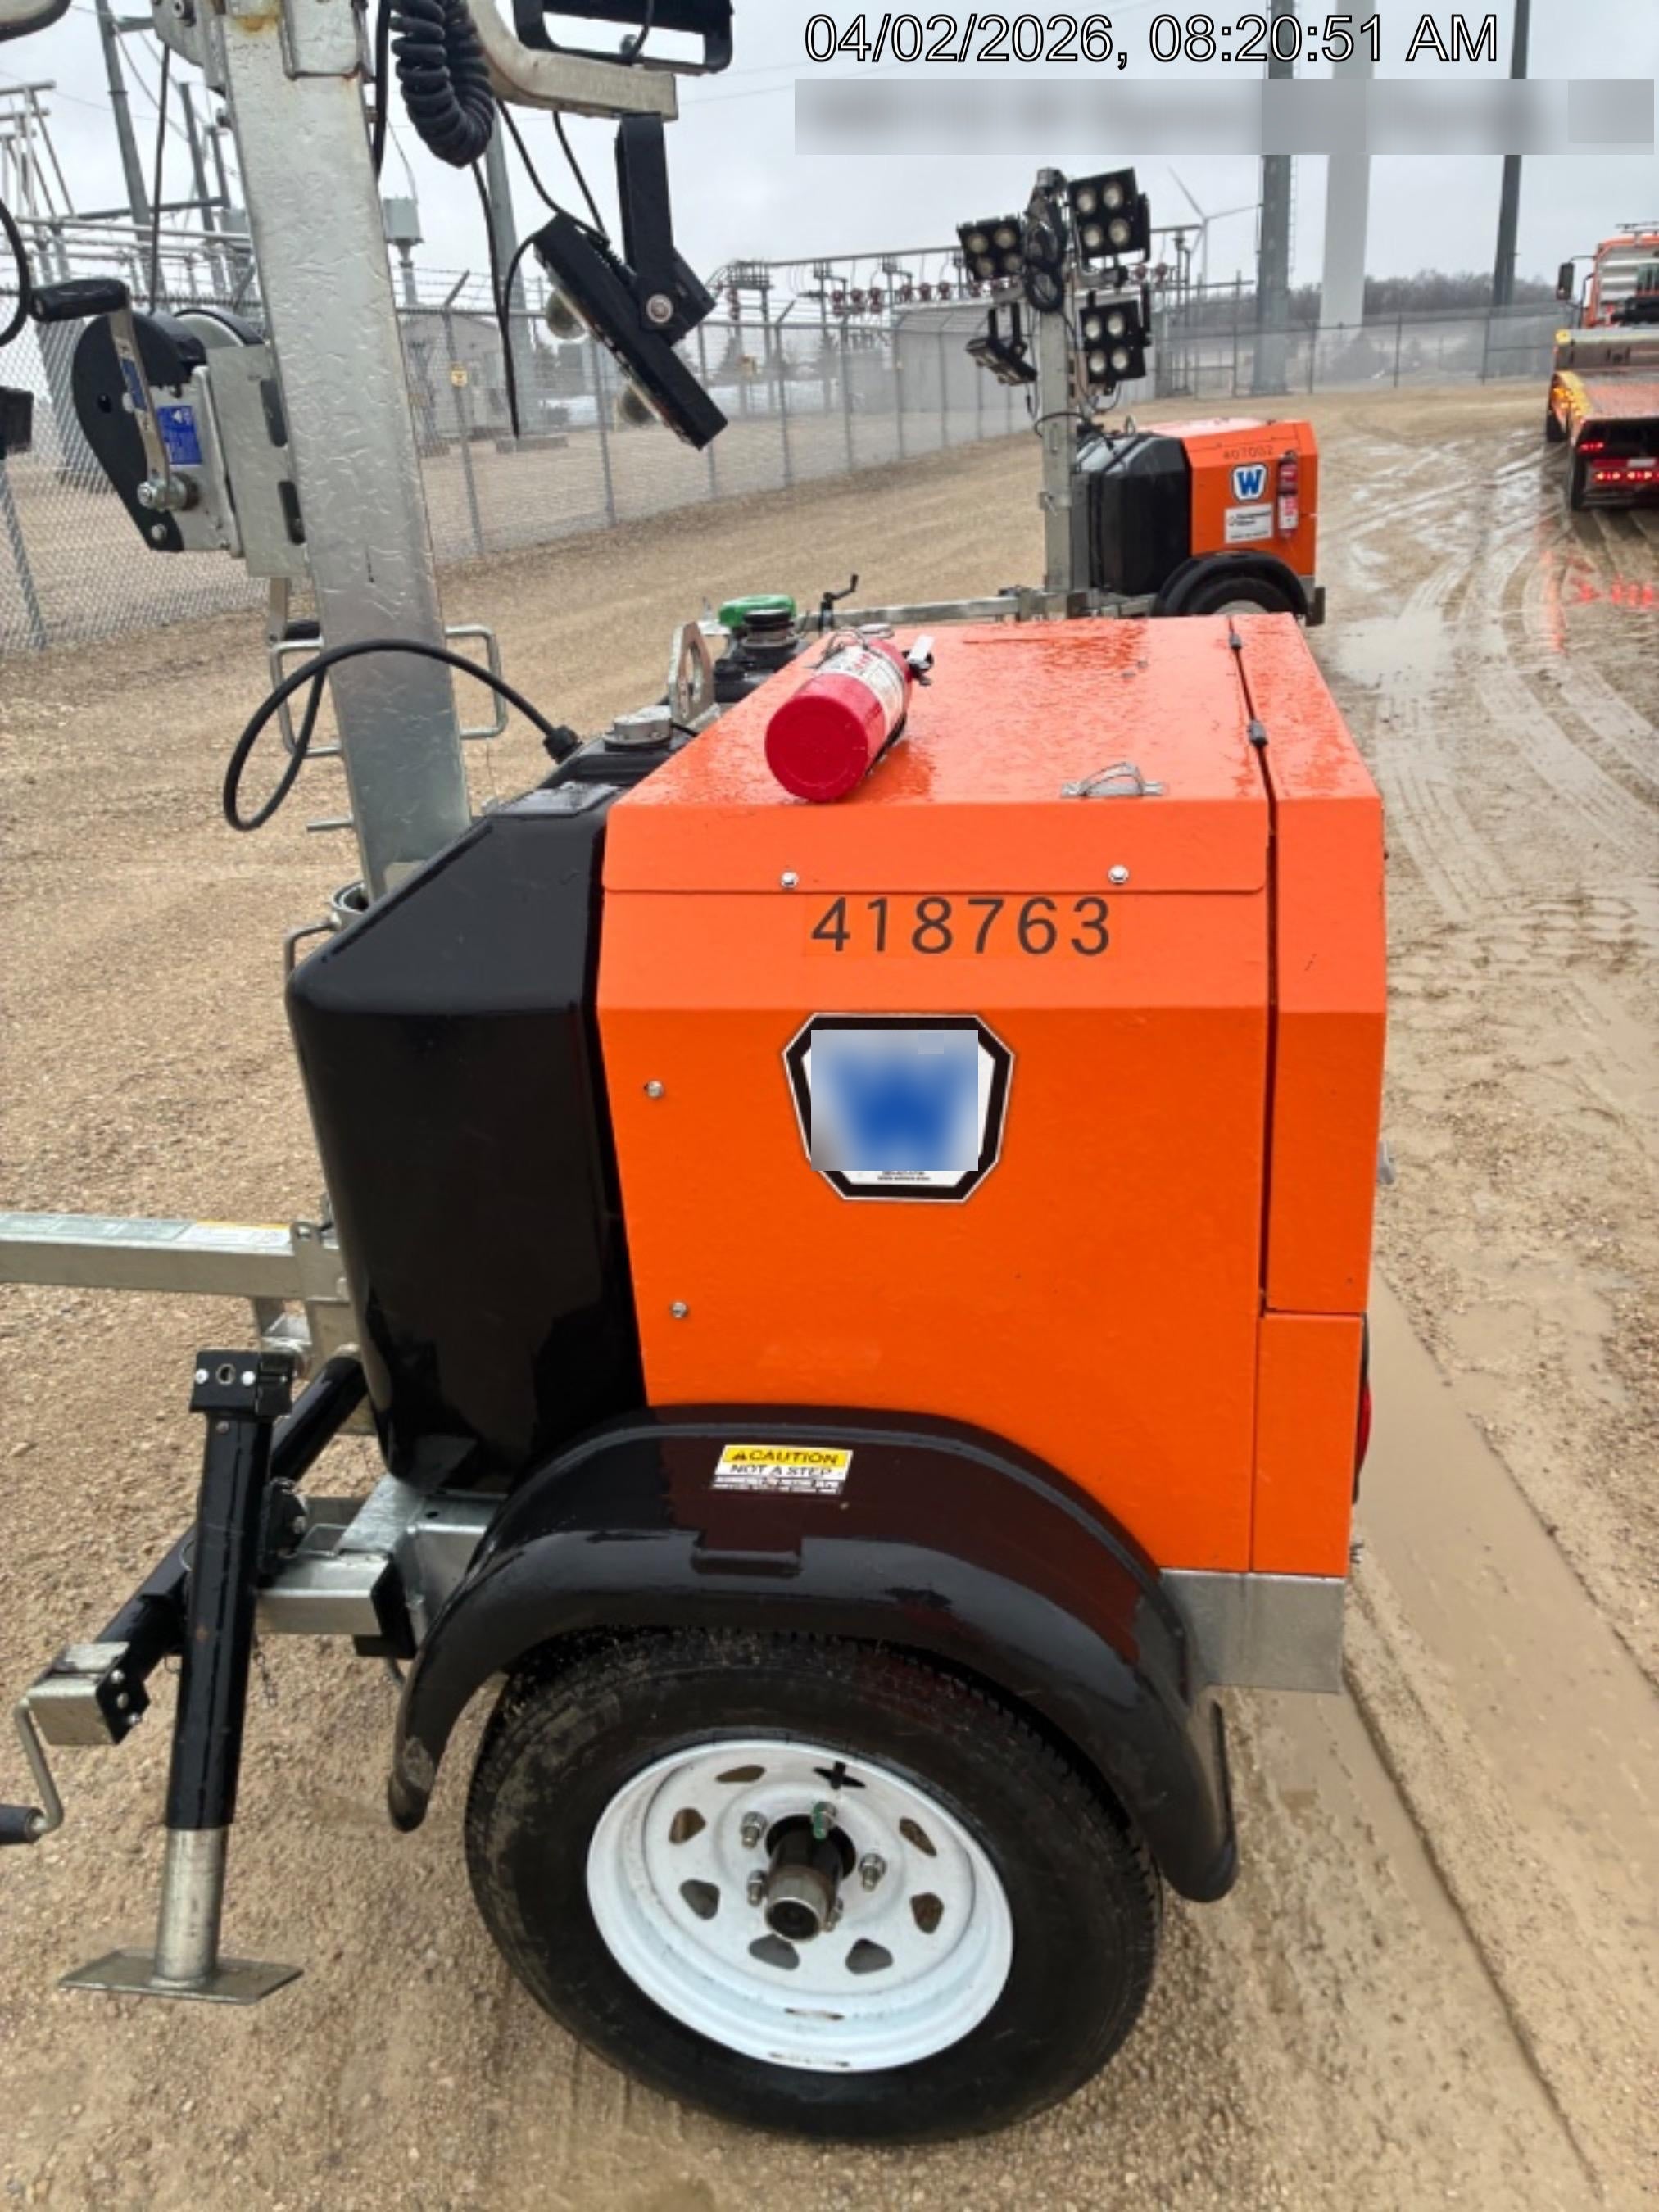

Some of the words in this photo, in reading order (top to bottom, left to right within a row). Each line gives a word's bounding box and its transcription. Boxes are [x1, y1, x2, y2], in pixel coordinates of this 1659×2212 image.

[1236, 469, 1263, 496] W
[811, 896, 1109, 955] 418763
[750, 1449, 839, 1464] CAUTION
[730, 1464, 767, 1474] NOT
[771, 1465, 782, 1475] A
[786, 1466, 832, 1476] STEP
